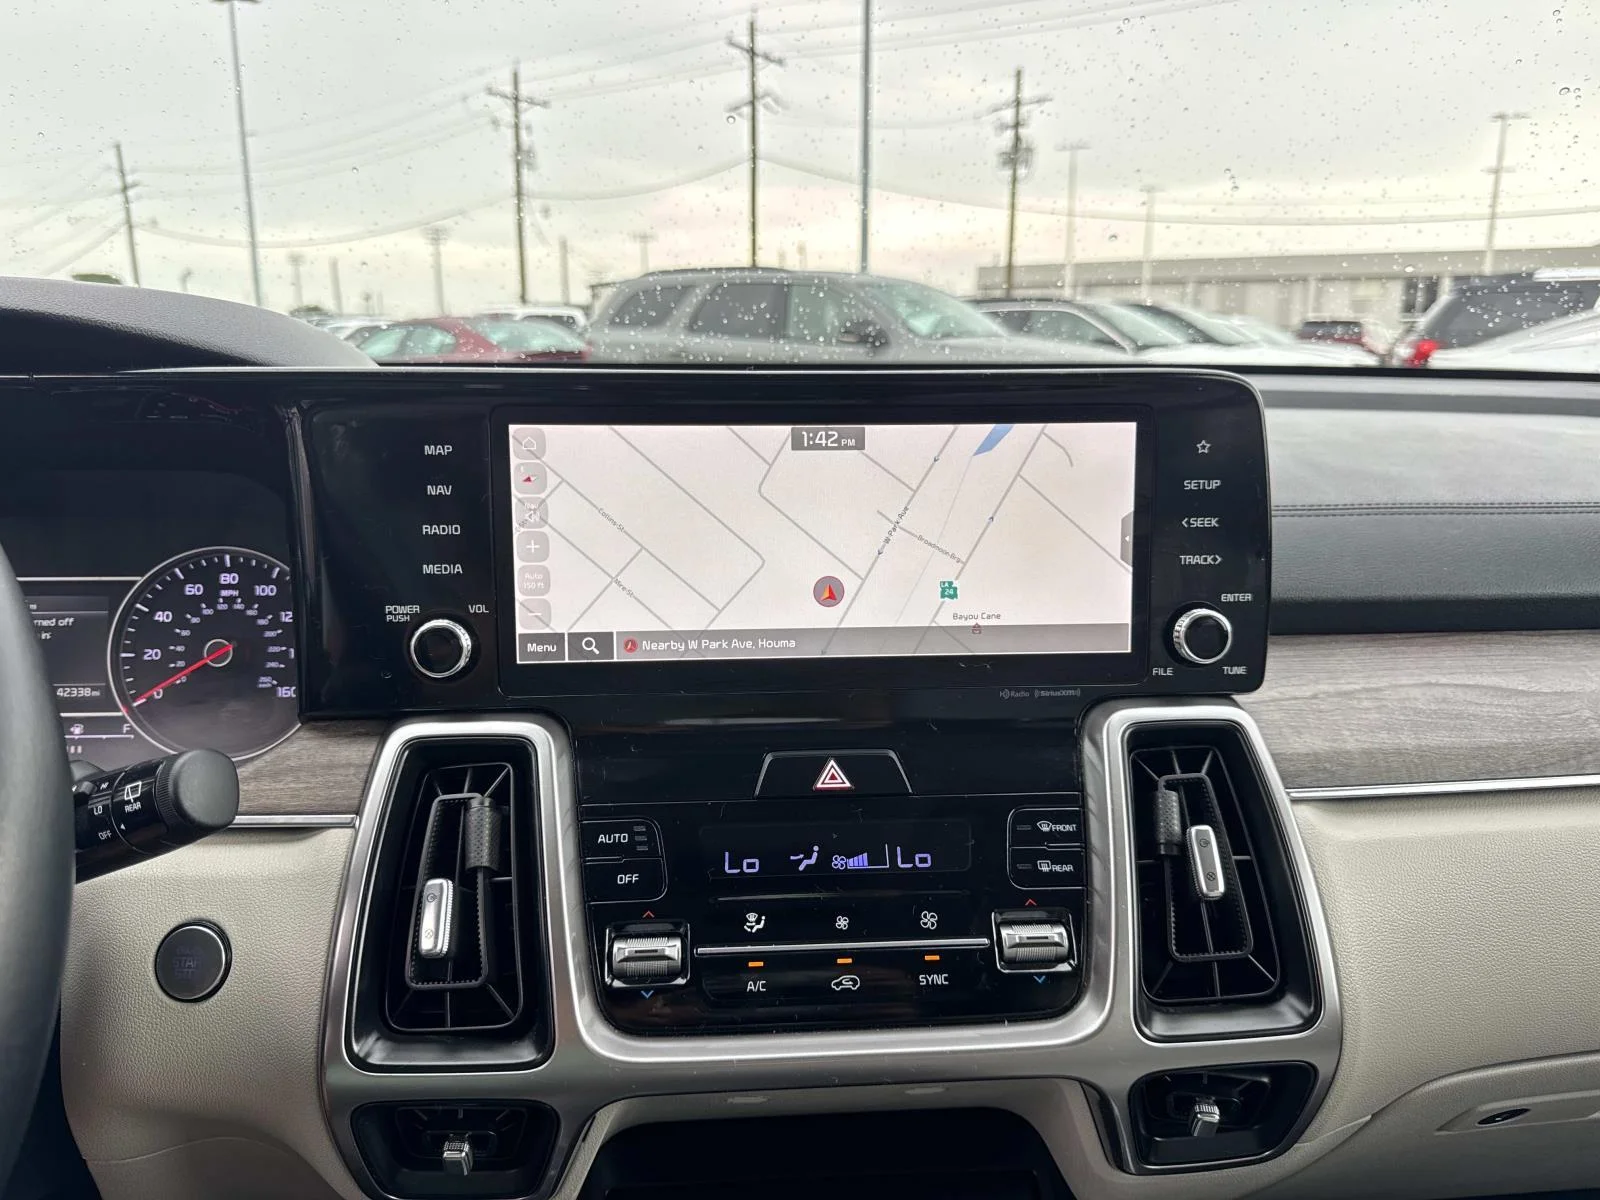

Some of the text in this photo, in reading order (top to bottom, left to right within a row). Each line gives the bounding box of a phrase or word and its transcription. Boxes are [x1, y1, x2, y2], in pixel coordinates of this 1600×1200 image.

[801, 431, 856, 447] 1:42 PM
[424, 445, 453, 455] MAP
[427, 485, 452, 495] NAV
[1184, 480, 1221, 490] SETUP
[898, 506, 910, 521] Ave
[422, 525, 461, 535] RADIO
[423, 564, 463, 574] MEDIA
[219, 574, 239, 584] 80
[184, 584, 204, 595] 60
[220, 589, 239, 597] MPH
[254, 585, 277, 596] 100
[944, 588, 954, 596] 24
[1221, 594, 1252, 602] ENTER
[385, 605, 420, 614] POWER
[468, 604, 489, 613] VOL
[58, 617, 75, 626] off
[154, 611, 173, 622] 40
[952, 612, 1001, 622] Bayou Cane
[527, 643, 557, 652] Menu
[642, 639, 685, 651] Nearby
[687, 639, 698, 649] W
[701, 639, 728, 649] Park
[758, 638, 796, 648] Houma
[143, 649, 161, 660] 20
[1153, 668, 1173, 676] FILE
[1222, 666, 1247, 674] TUNE
[153, 689, 163, 699] 0
[123, 724, 131, 733] F
[93, 805, 103, 816] LO
[124, 802, 142, 814] REAR
[1051, 824, 1077, 832] FRONT
[98, 832, 112, 842] OFF
[597, 833, 629, 844] AUTO
[724, 851, 760, 873] Lo
[897, 846, 931, 868] Lo
[1051, 864, 1074, 872] REAR
[617, 873, 640, 885] OFF
[919, 973, 949, 985] SYNC
[746, 980, 767, 992] A/C
